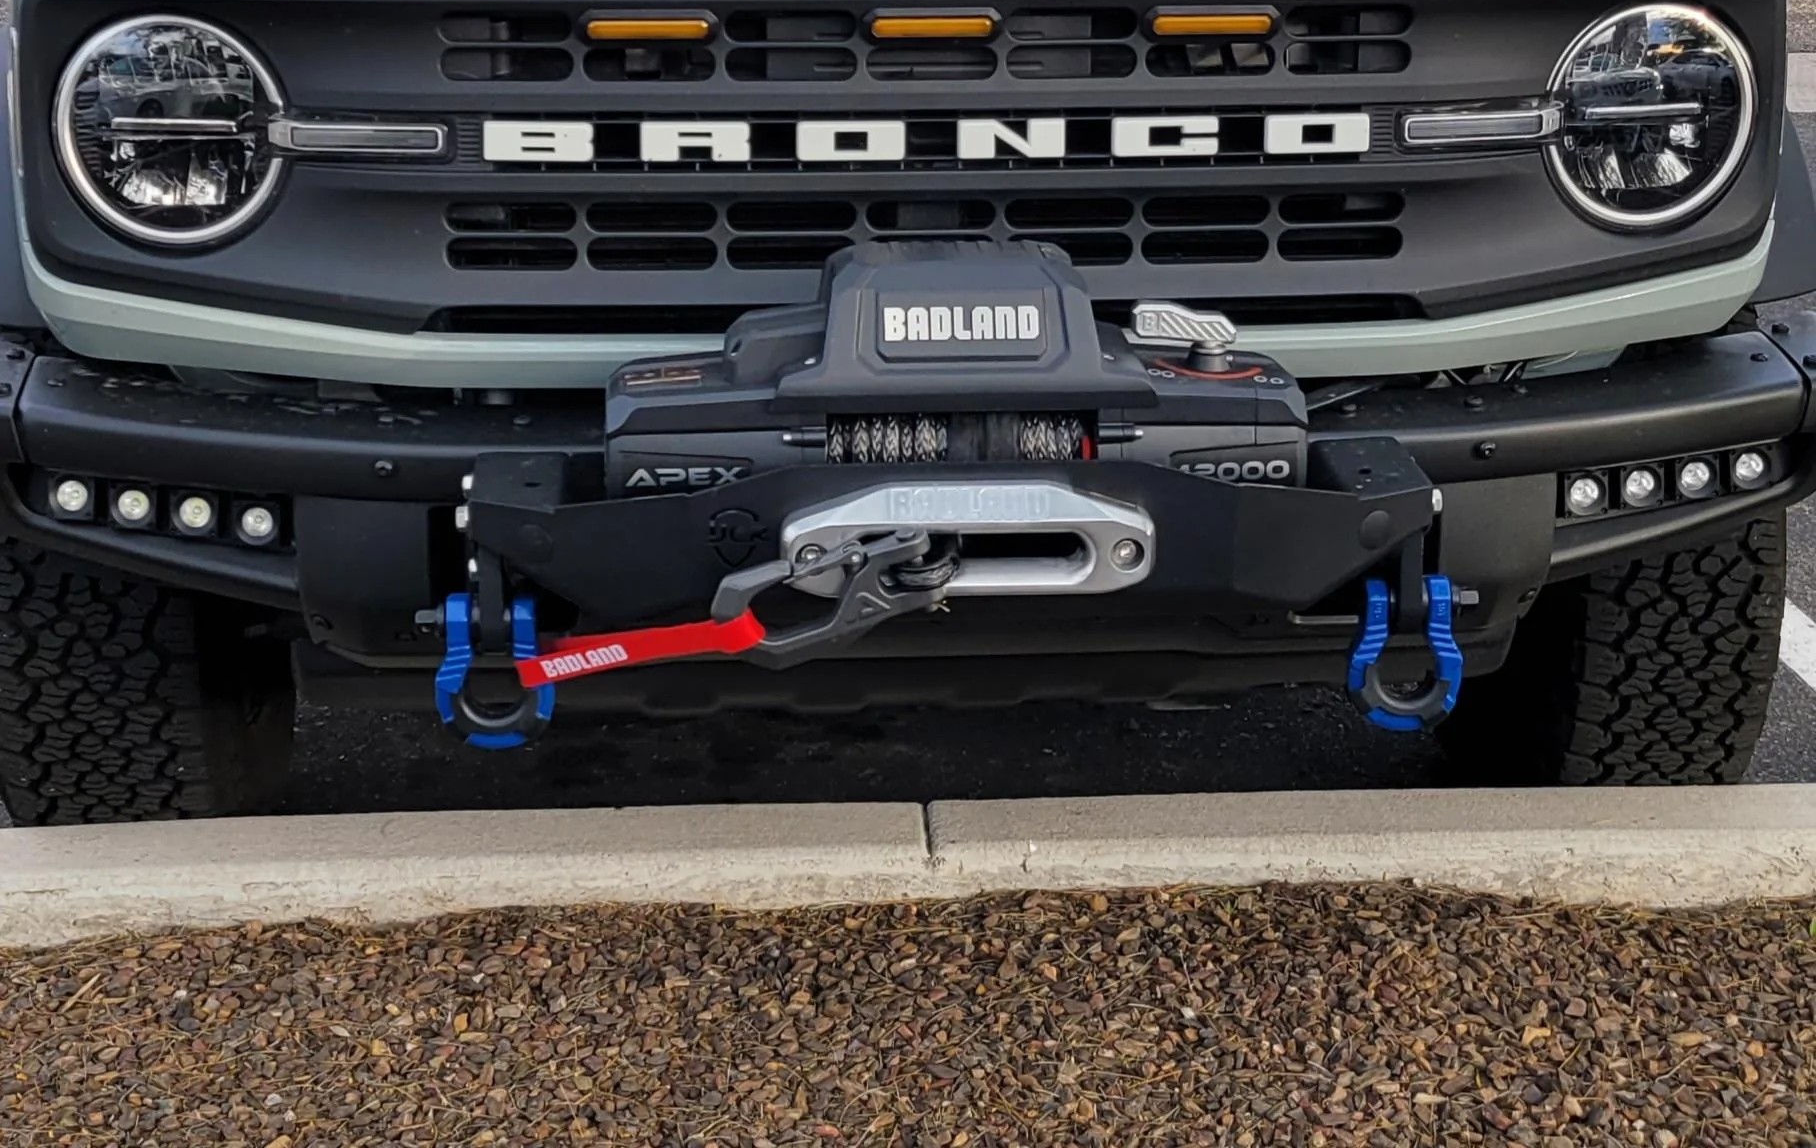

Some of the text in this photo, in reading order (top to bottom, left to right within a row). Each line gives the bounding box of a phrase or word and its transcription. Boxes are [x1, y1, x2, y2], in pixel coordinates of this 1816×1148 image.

[483, 113, 1371, 163] BRONCO
[883, 305, 1040, 342] BADLAND
[626, 466, 743, 487] APEX
[540, 644, 628, 678] BADLAND
